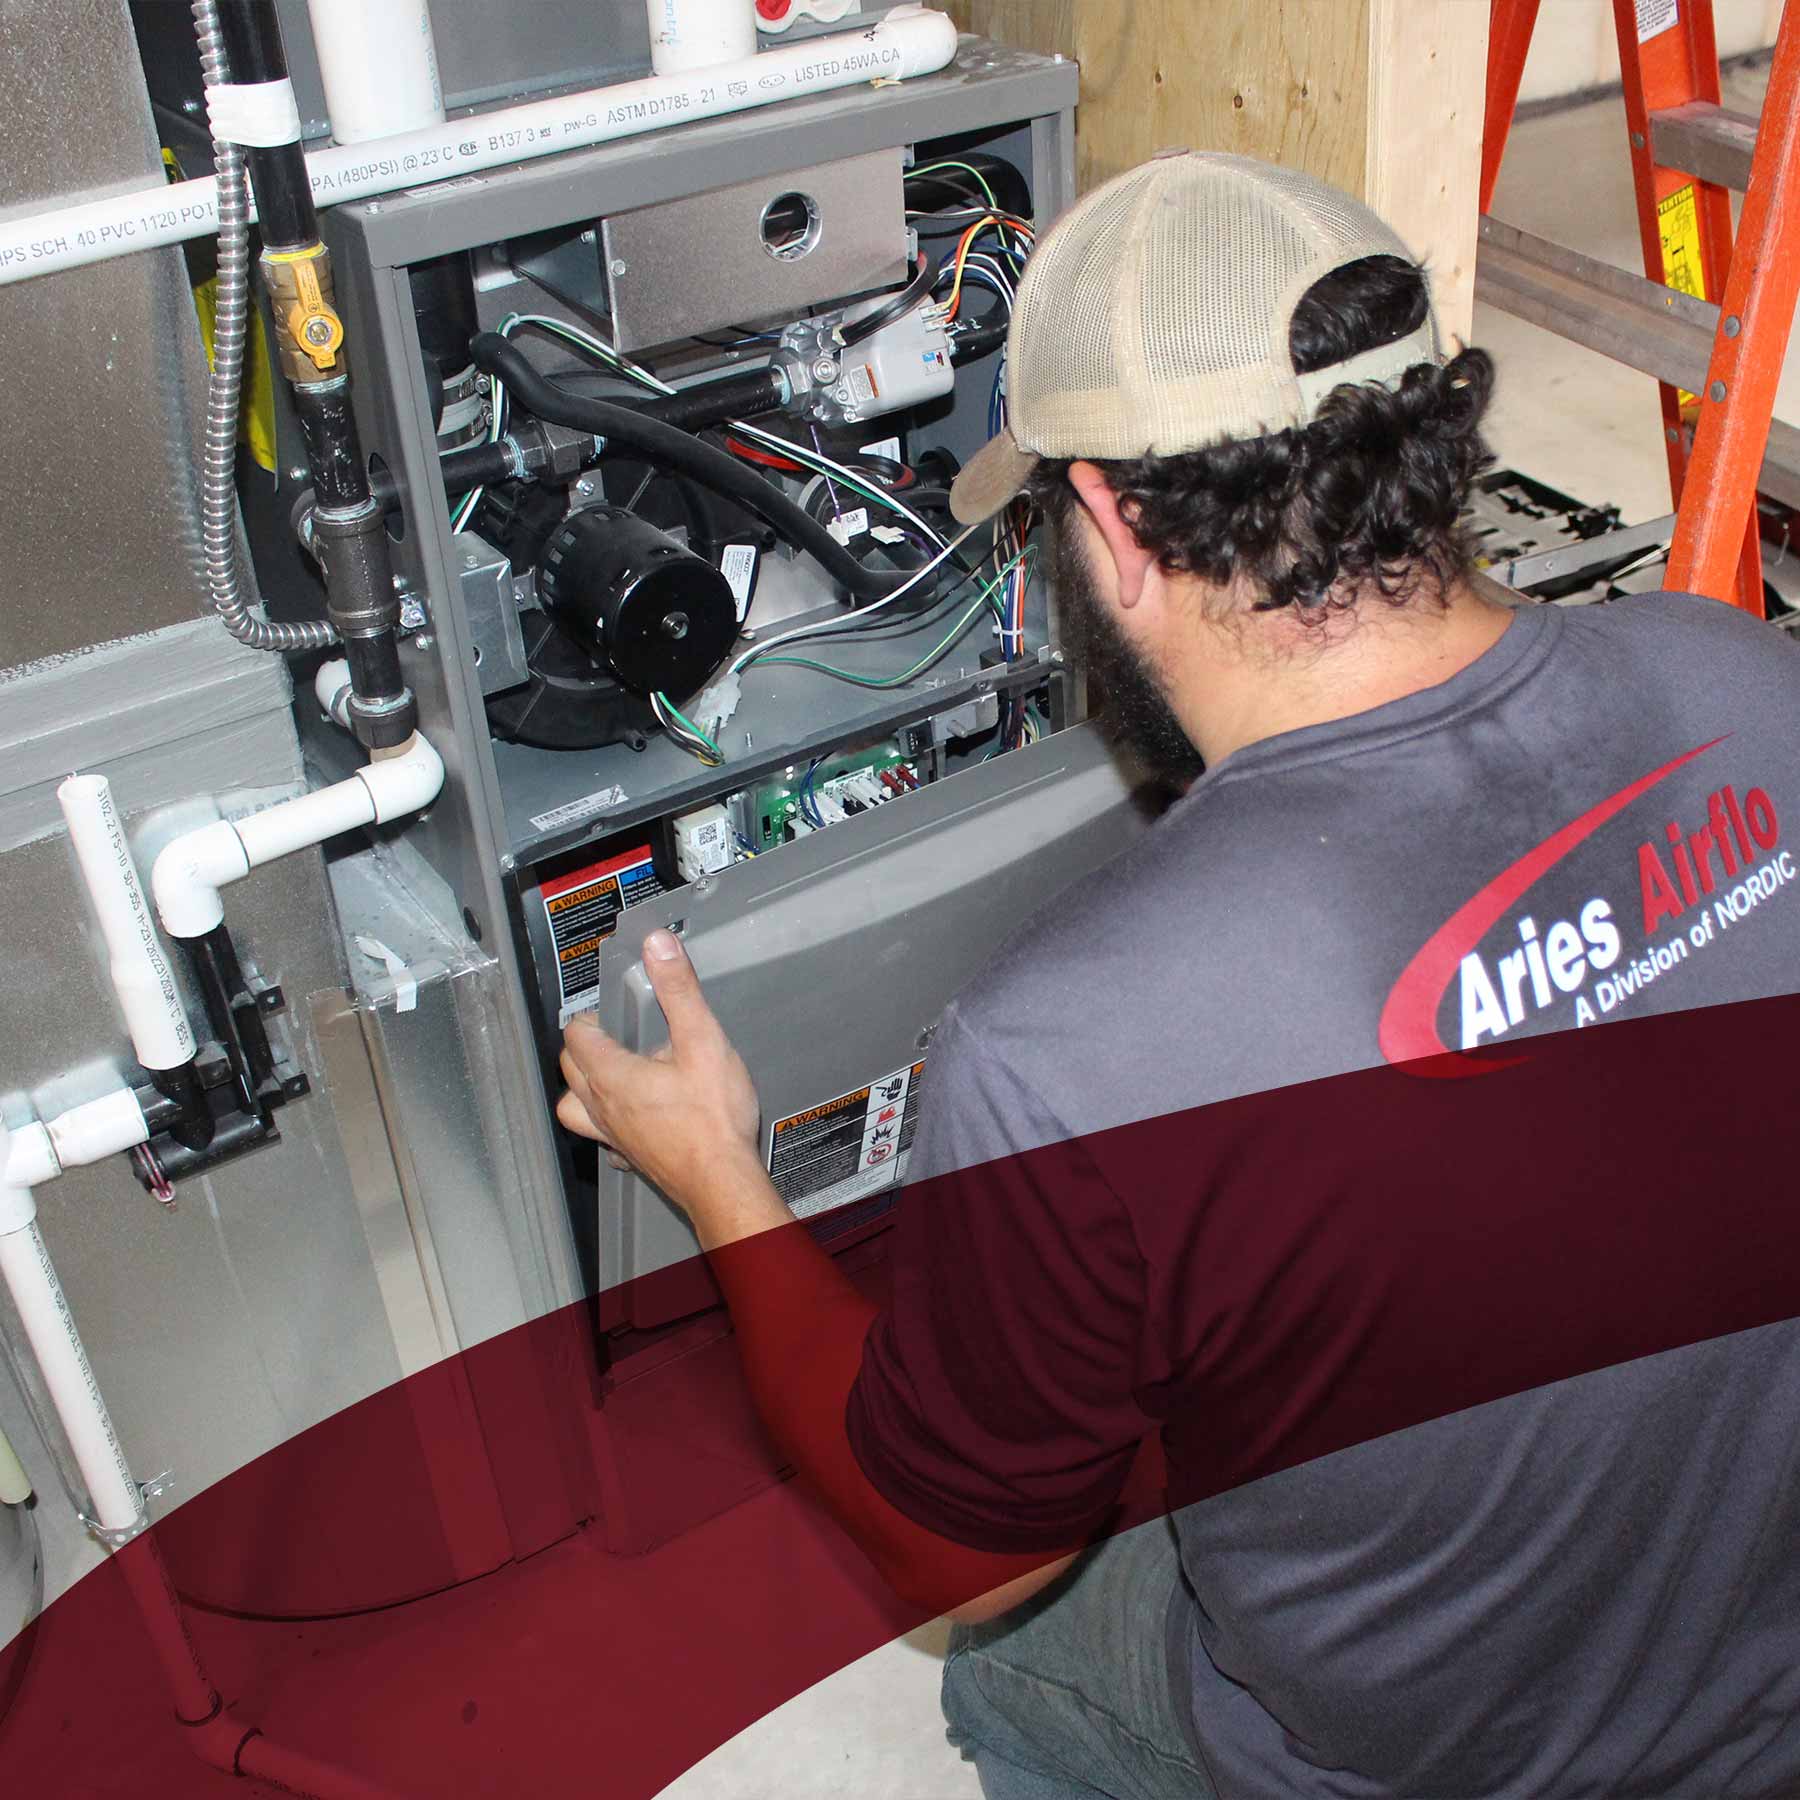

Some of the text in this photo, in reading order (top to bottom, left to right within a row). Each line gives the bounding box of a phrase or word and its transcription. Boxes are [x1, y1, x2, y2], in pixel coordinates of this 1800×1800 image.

[30, 239, 72, 260] SCH.
[77, 230, 97, 249] 40
[100, 220, 136, 244] PVC
[141, 211, 177, 233] 1120
[338, 160, 400, 188] (480PSI)
[403, 154, 419, 173] @
[421, 150, 439, 168] 23
[607, 103, 647, 125] ASTM
[649, 94, 690, 114] D1785
[701, 88, 716, 104] 21
[795, 60, 840, 83] LISTED
[843, 52, 879, 72] 45WA
[561, 880, 615, 908] WARNING
[1459, 784, 1780, 1053] Aries Airflo
[1576, 850, 1797, 1028] A Division of NORDIC
[796, 1092, 865, 1126] WARNING
